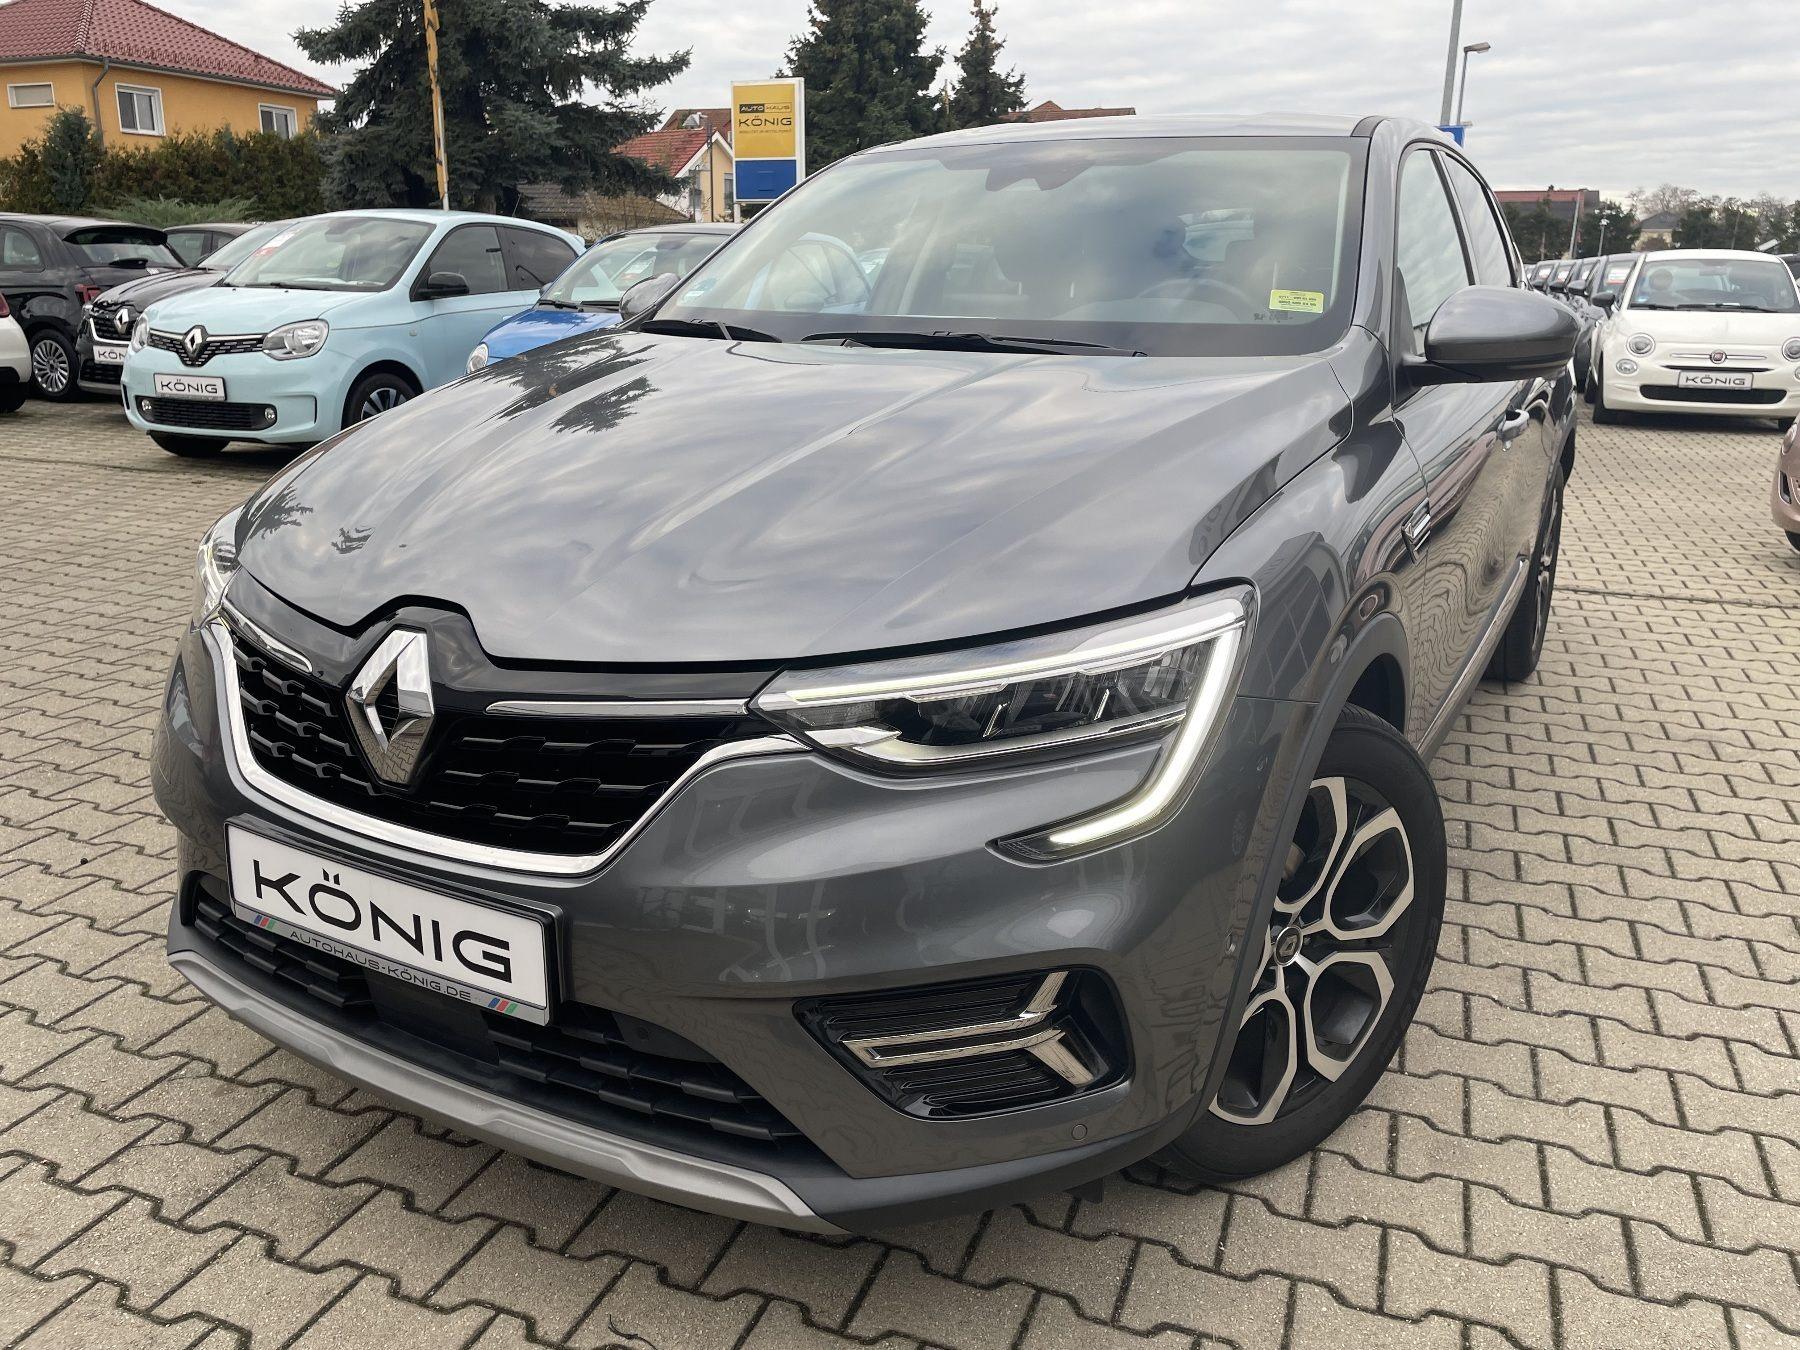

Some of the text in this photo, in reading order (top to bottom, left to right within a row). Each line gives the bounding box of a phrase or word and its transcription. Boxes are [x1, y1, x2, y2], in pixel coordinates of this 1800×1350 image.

[738, 115, 792, 127] KÖNIG
[98, 349, 127, 360] KÖN
[160, 379, 218, 394] KÖNIG
[1685, 374, 1746, 386] KÖNIG
[253, 859, 513, 984] KÖNIG
[289, 930, 472, 1001] AUTOHAUS-KÖNIG.DE
